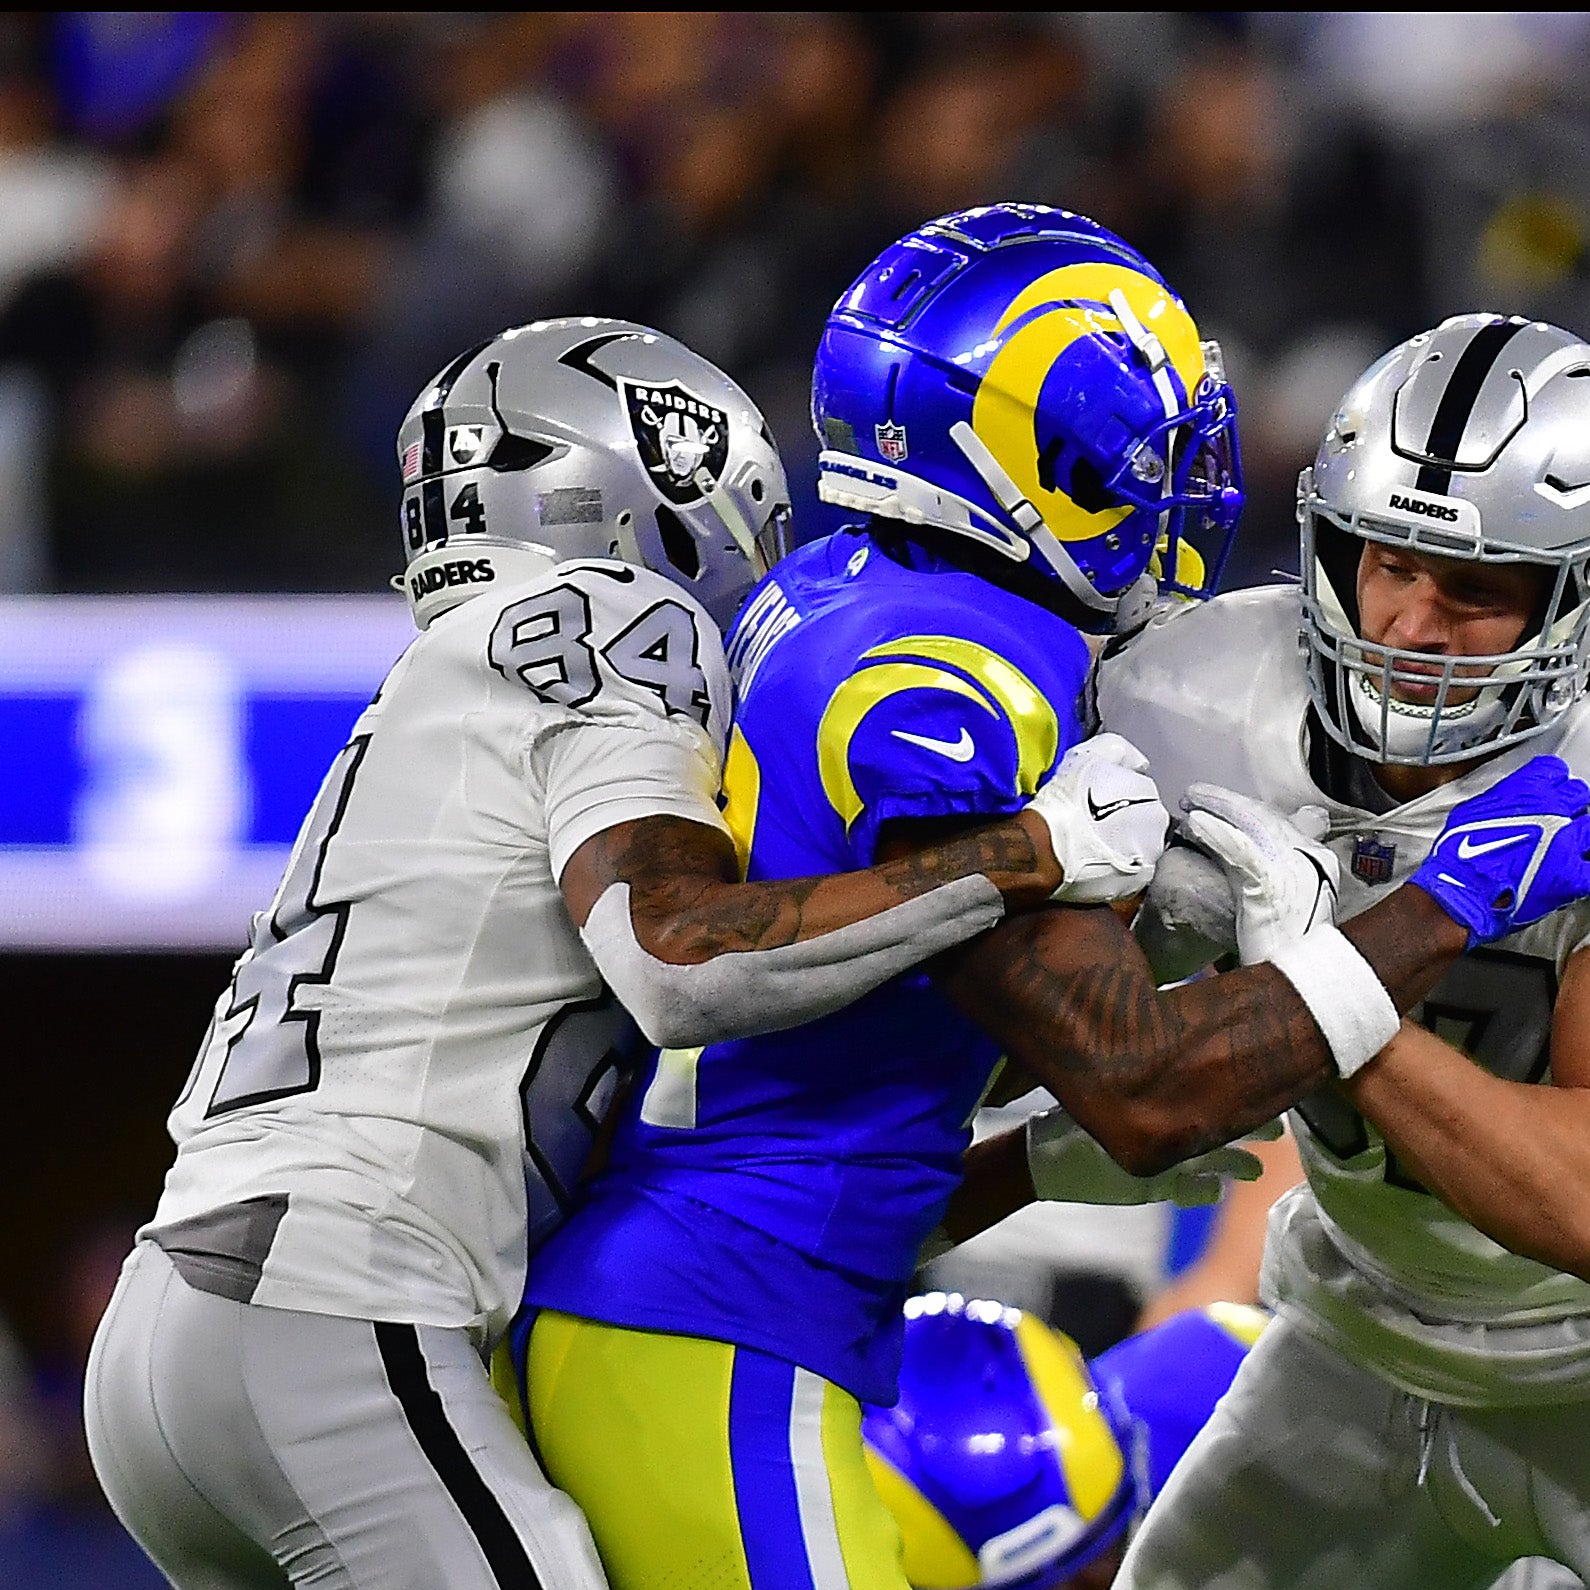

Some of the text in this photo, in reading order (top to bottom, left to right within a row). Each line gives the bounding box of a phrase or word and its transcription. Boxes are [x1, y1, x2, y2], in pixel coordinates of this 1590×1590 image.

[635, 387, 721, 423] RAIDERS
[1389, 494, 1459, 522] RAIDERS
[410, 559, 496, 600] RAIDERS
[488, 583, 711, 729] 84
